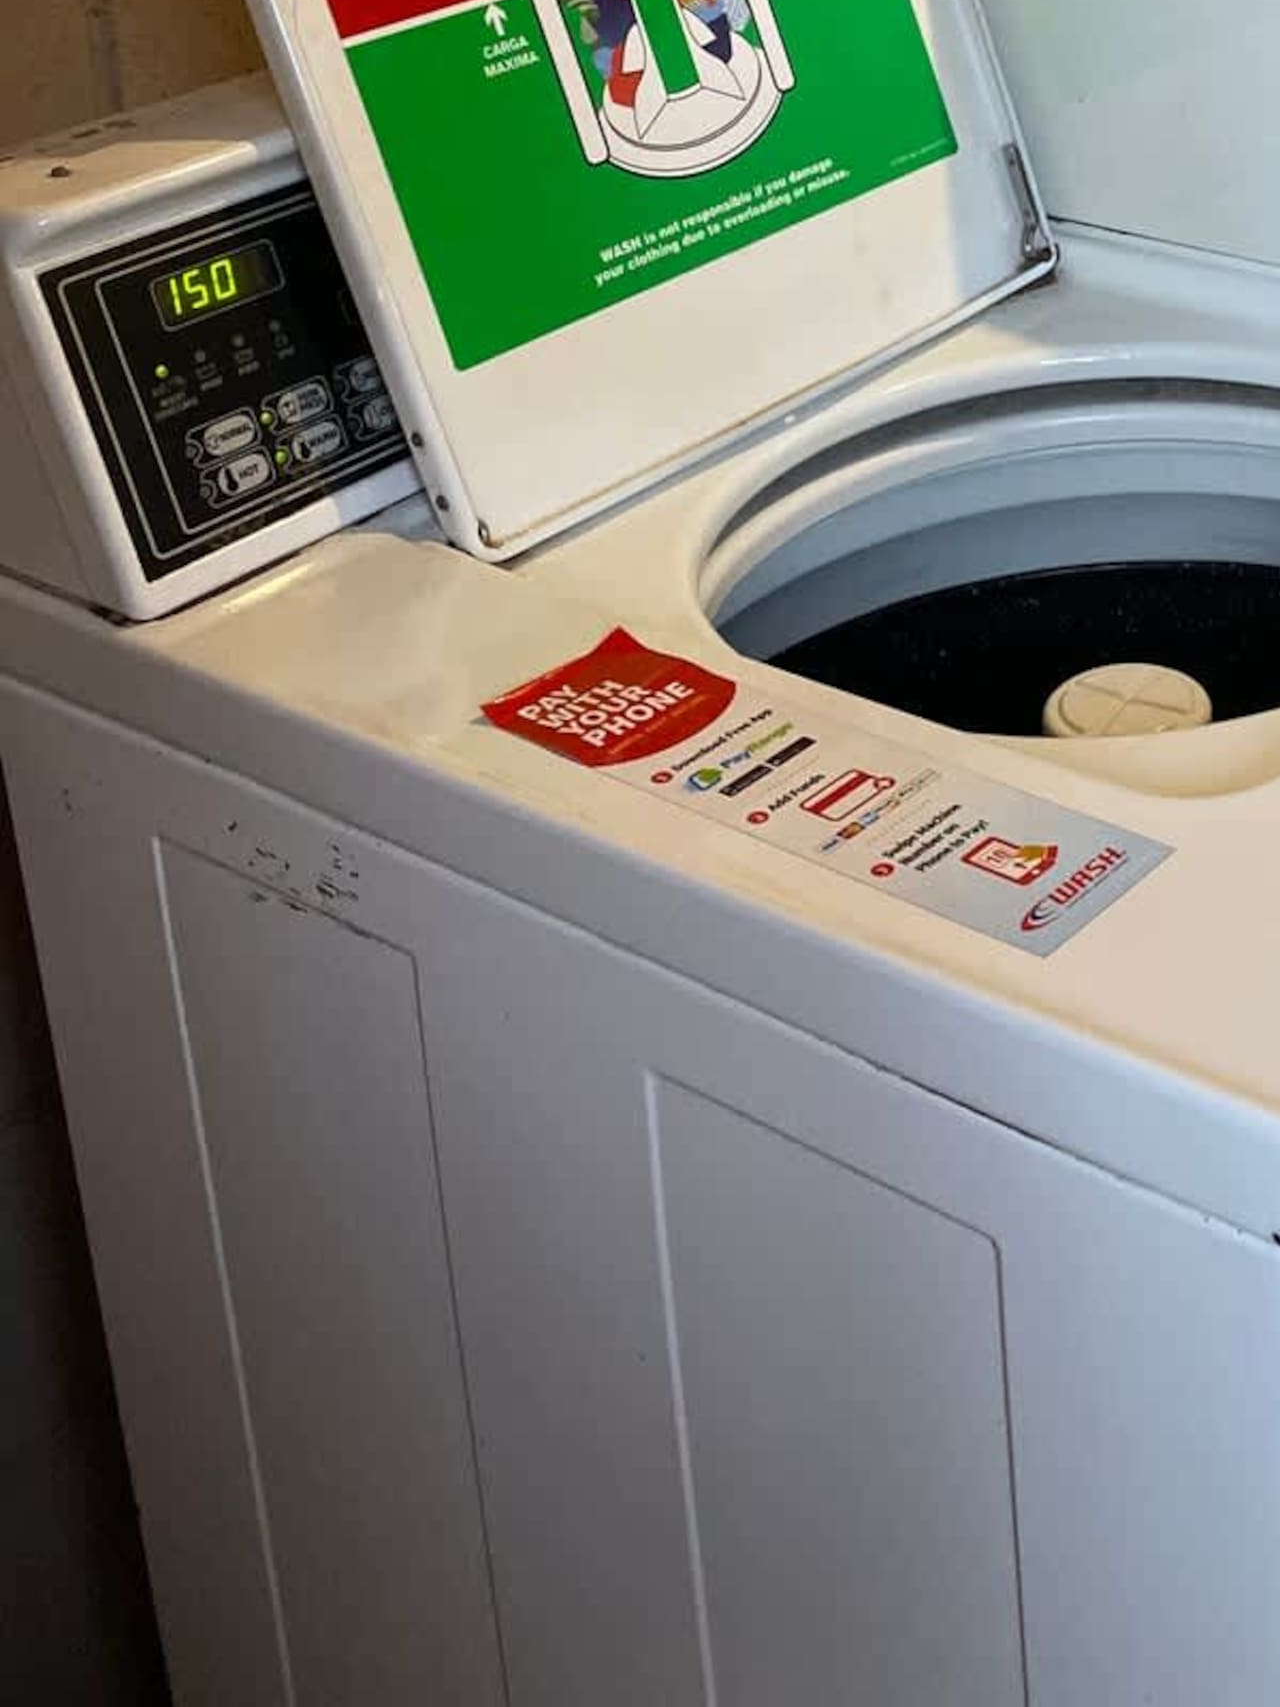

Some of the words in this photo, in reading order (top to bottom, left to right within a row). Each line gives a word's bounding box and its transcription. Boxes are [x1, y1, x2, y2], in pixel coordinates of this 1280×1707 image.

[482, 35, 529, 60] CARGA
[482, 52, 540, 80] MAXIMA
[594, 263, 625, 287] your
[627, 239, 681, 271] clothing
[681, 229, 706, 246] due
[706, 222, 722, 237] to
[723, 191, 792, 228] overloading
[793, 186, 805, 200] or
[599, 236, 643, 264] WASH
[643, 232, 657, 245] is
[658, 222, 681, 240] not
[681, 191, 752, 228] responsible
[753, 184, 764, 201] if
[764, 178, 787, 198] you
[788, 158, 834, 184] damage
[168, 258, 237, 316] 150
[238, 462, 260, 480] HOT
[518, 684, 582, 723] PAY
[539, 679, 627, 729] WITH
[558, 683, 650, 737] YOUR
[581, 681, 695, 748] PHONE
[672, 736, 728, 771] Download
[750, 709, 772, 723] App
[768, 794, 793, 812] Add
[791, 773, 826, 796] Funds
[882, 834, 918, 858] Swipe
[914, 804, 962, 835] Machine
[898, 834, 944, 865] Number
[942, 823, 960, 835] on
[914, 847, 952, 872] Phone
[950, 838, 966, 849] to
[1048, 844, 1126, 907] WASH
